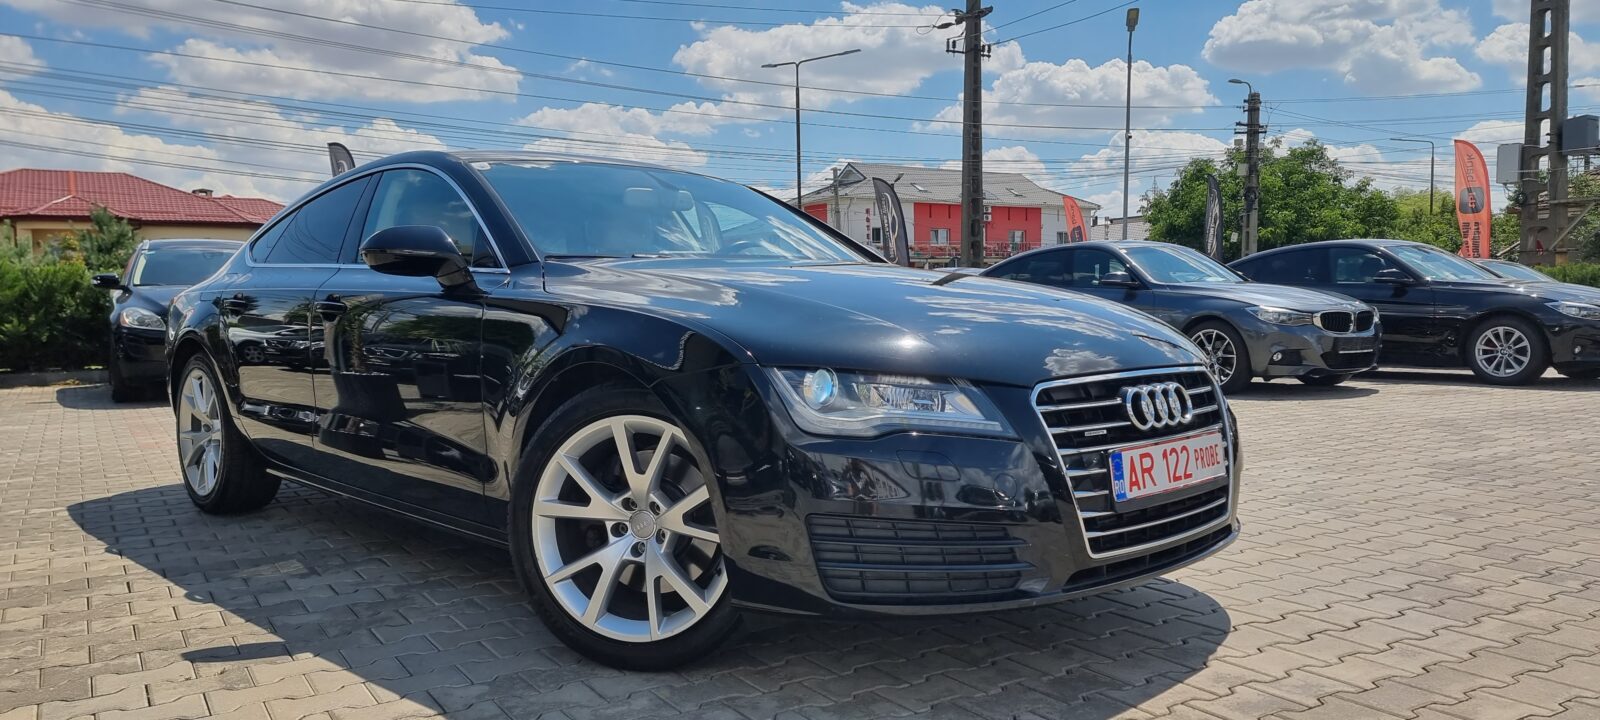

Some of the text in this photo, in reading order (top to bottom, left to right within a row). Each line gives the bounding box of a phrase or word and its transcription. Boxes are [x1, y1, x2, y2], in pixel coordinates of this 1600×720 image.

[1129, 444, 1220, 492] AR 122 PROBE
[1115, 480, 1125, 495] RO
